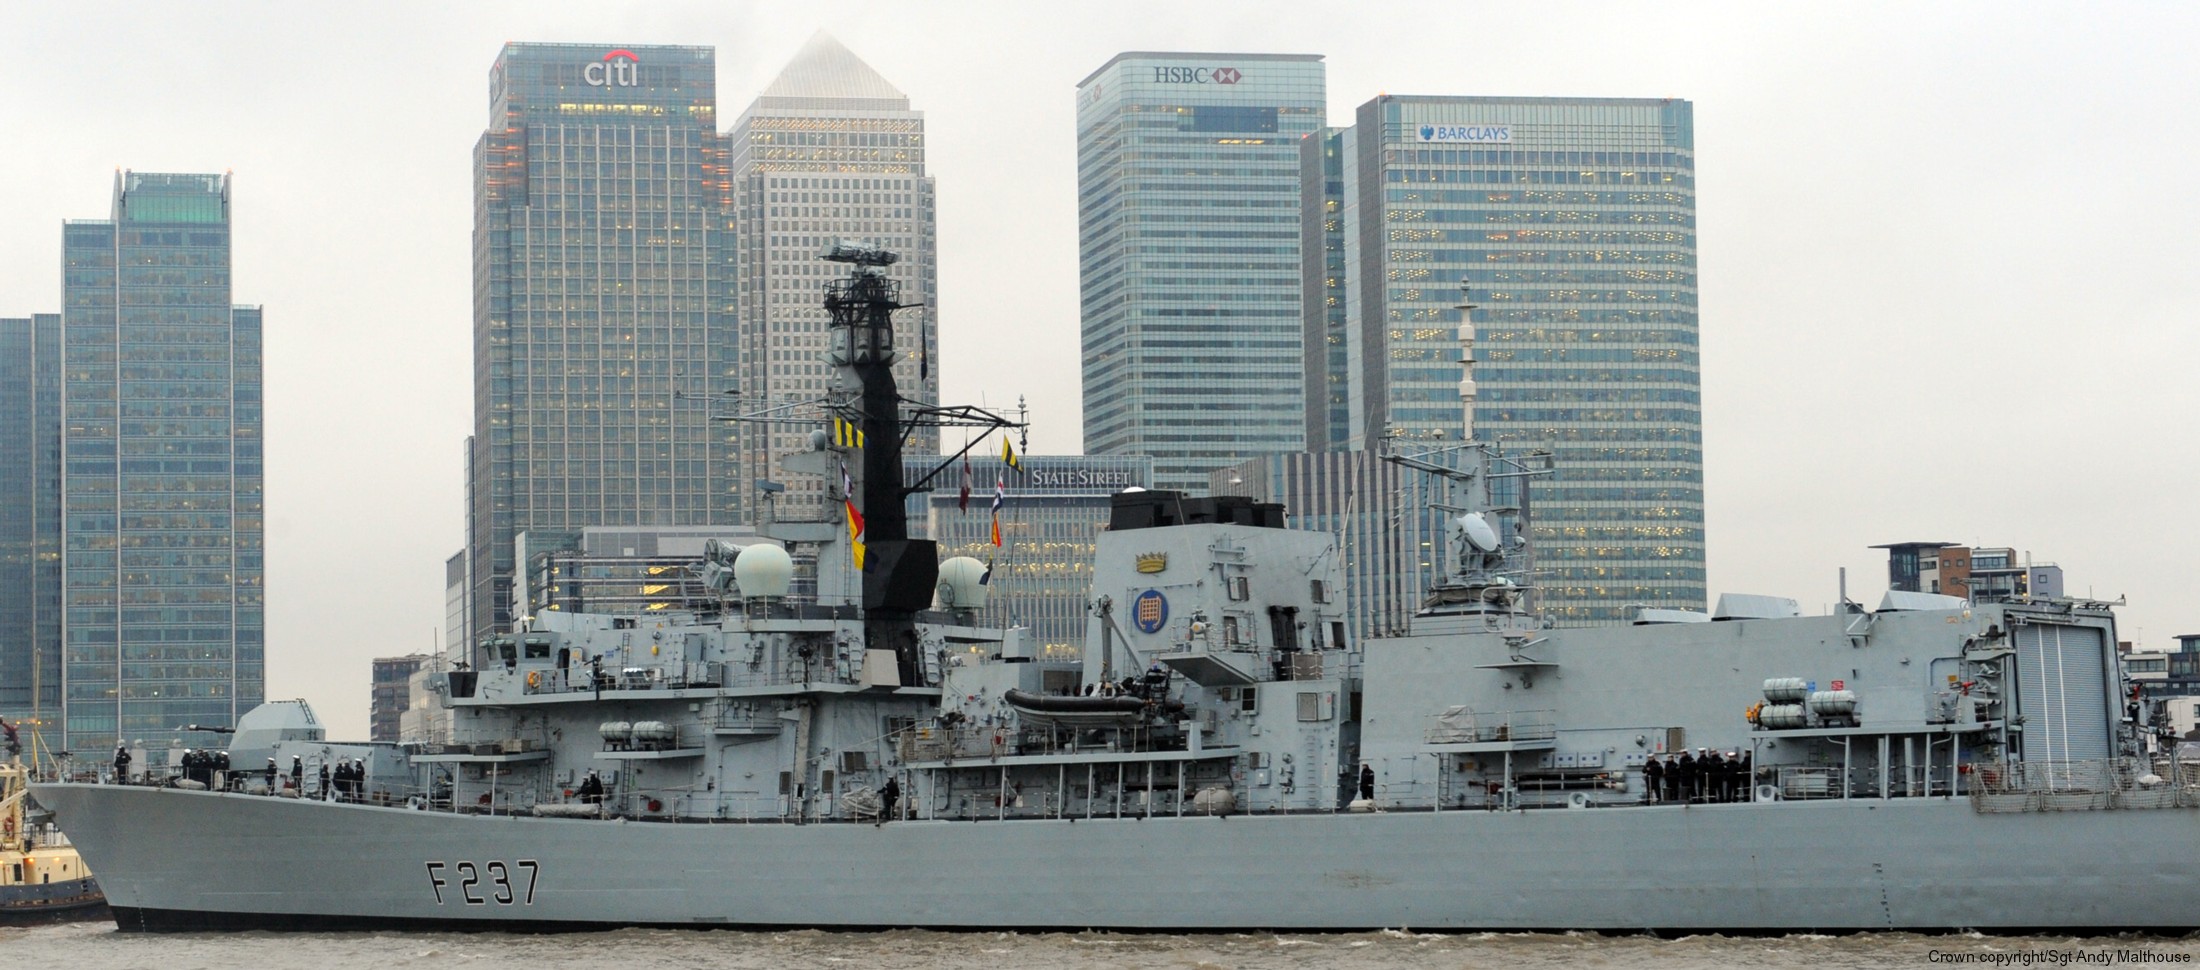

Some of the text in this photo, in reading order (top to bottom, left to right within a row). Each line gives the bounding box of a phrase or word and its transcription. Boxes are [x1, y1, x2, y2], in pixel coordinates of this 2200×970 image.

[584, 57, 637, 87] citi
[1154, 67, 1209, 84] HSBC
[1437, 126, 1509, 141] BARCLAYS
[1033, 465, 1130, 486] STATE STREET
[425, 860, 540, 906] F237
